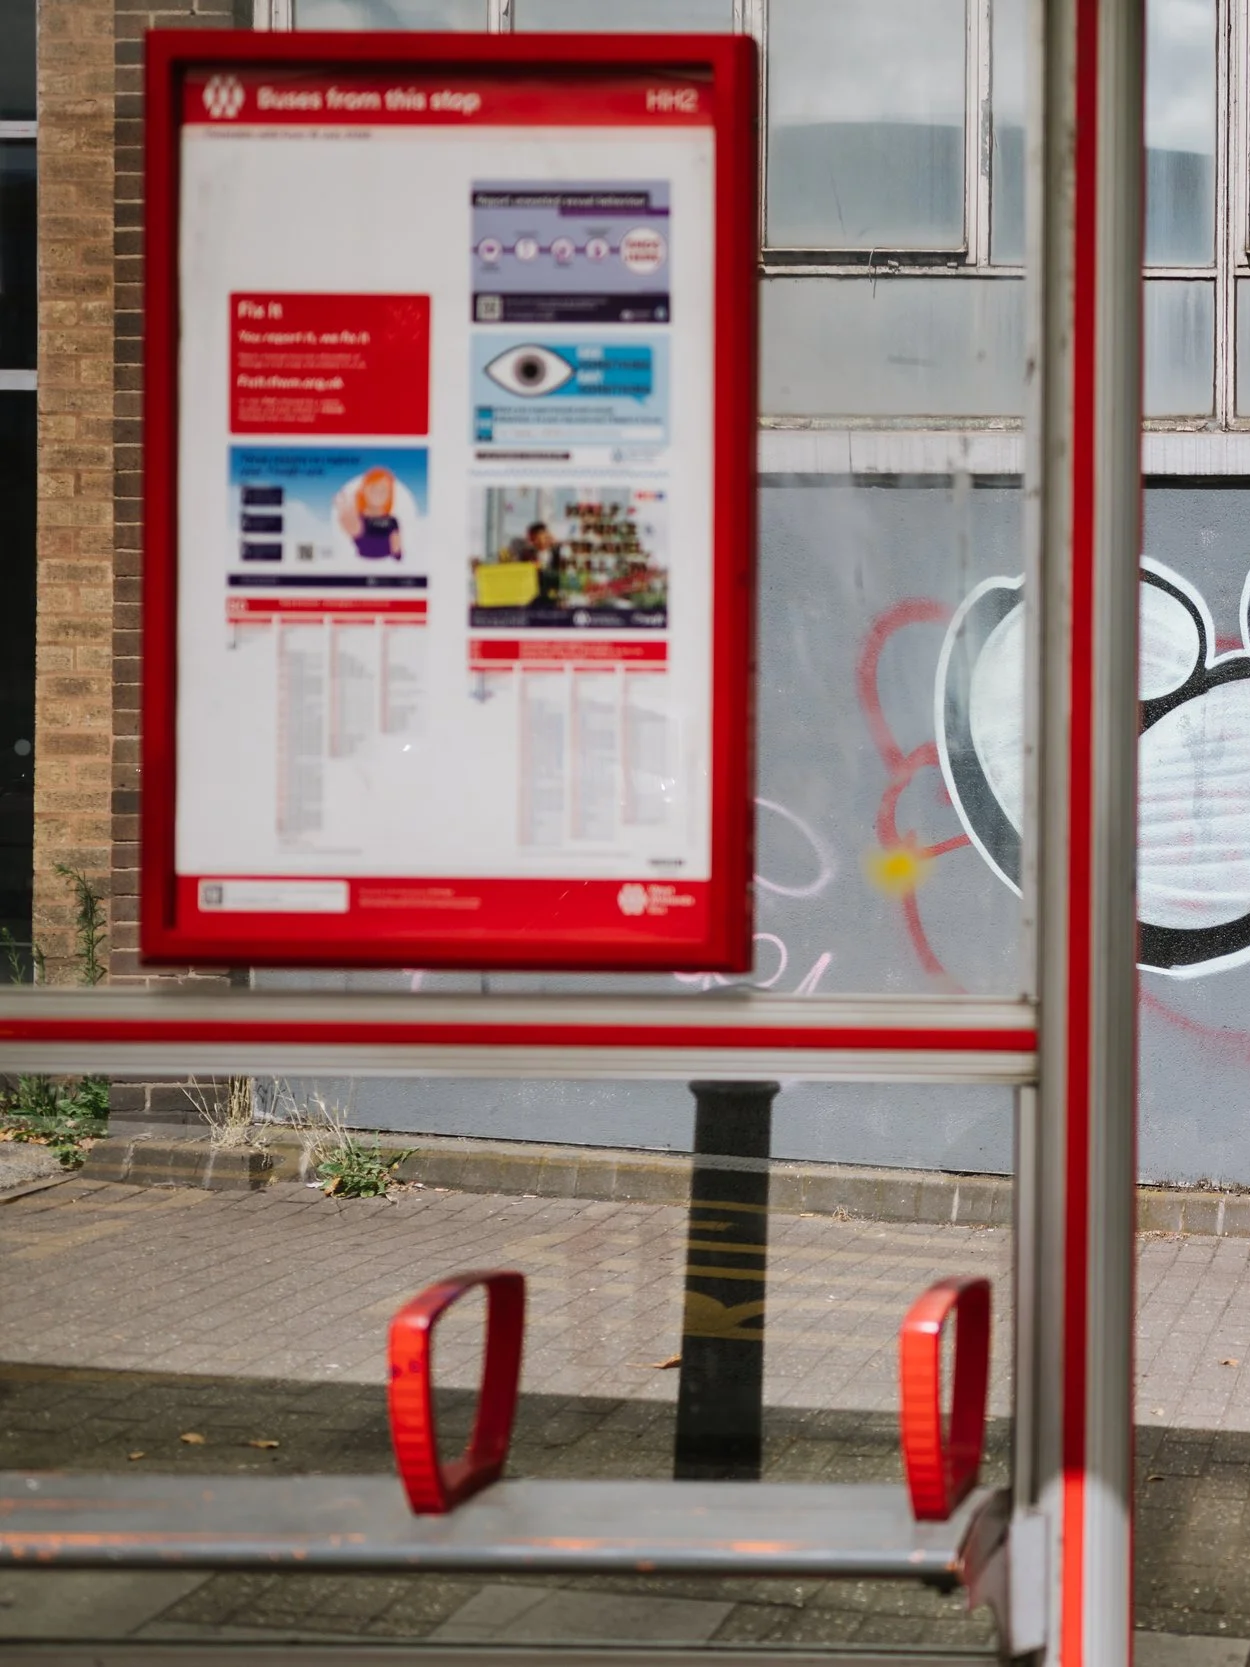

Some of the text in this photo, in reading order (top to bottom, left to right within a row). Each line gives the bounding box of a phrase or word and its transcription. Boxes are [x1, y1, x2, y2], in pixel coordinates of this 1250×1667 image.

[257, 86, 481, 114] Buses from this stop
[646, 90, 698, 112] HH2
